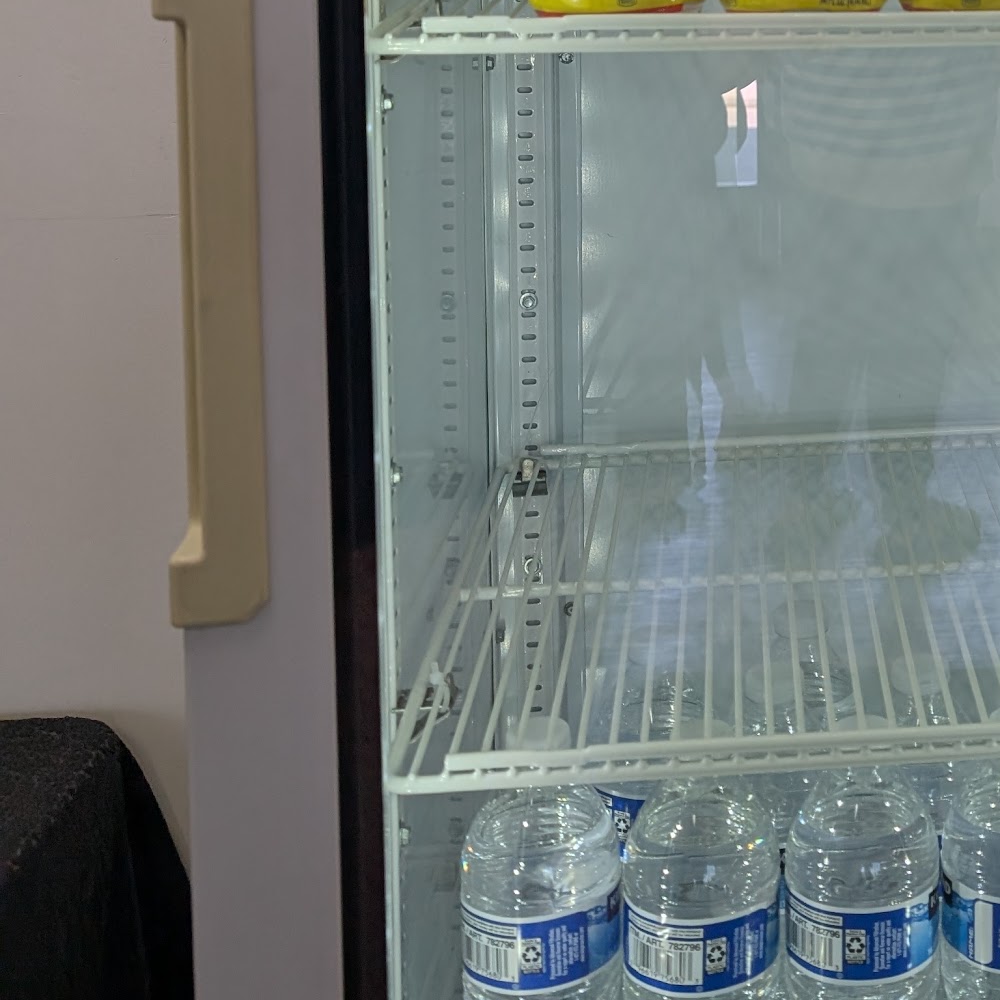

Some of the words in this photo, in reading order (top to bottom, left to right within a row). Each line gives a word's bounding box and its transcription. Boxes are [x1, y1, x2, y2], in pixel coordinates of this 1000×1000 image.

[811, 924, 840, 939] 782796
[486, 936, 515, 950] 782796
[646, 936, 664, 949] ART.
[668, 942, 701, 952] 782796
